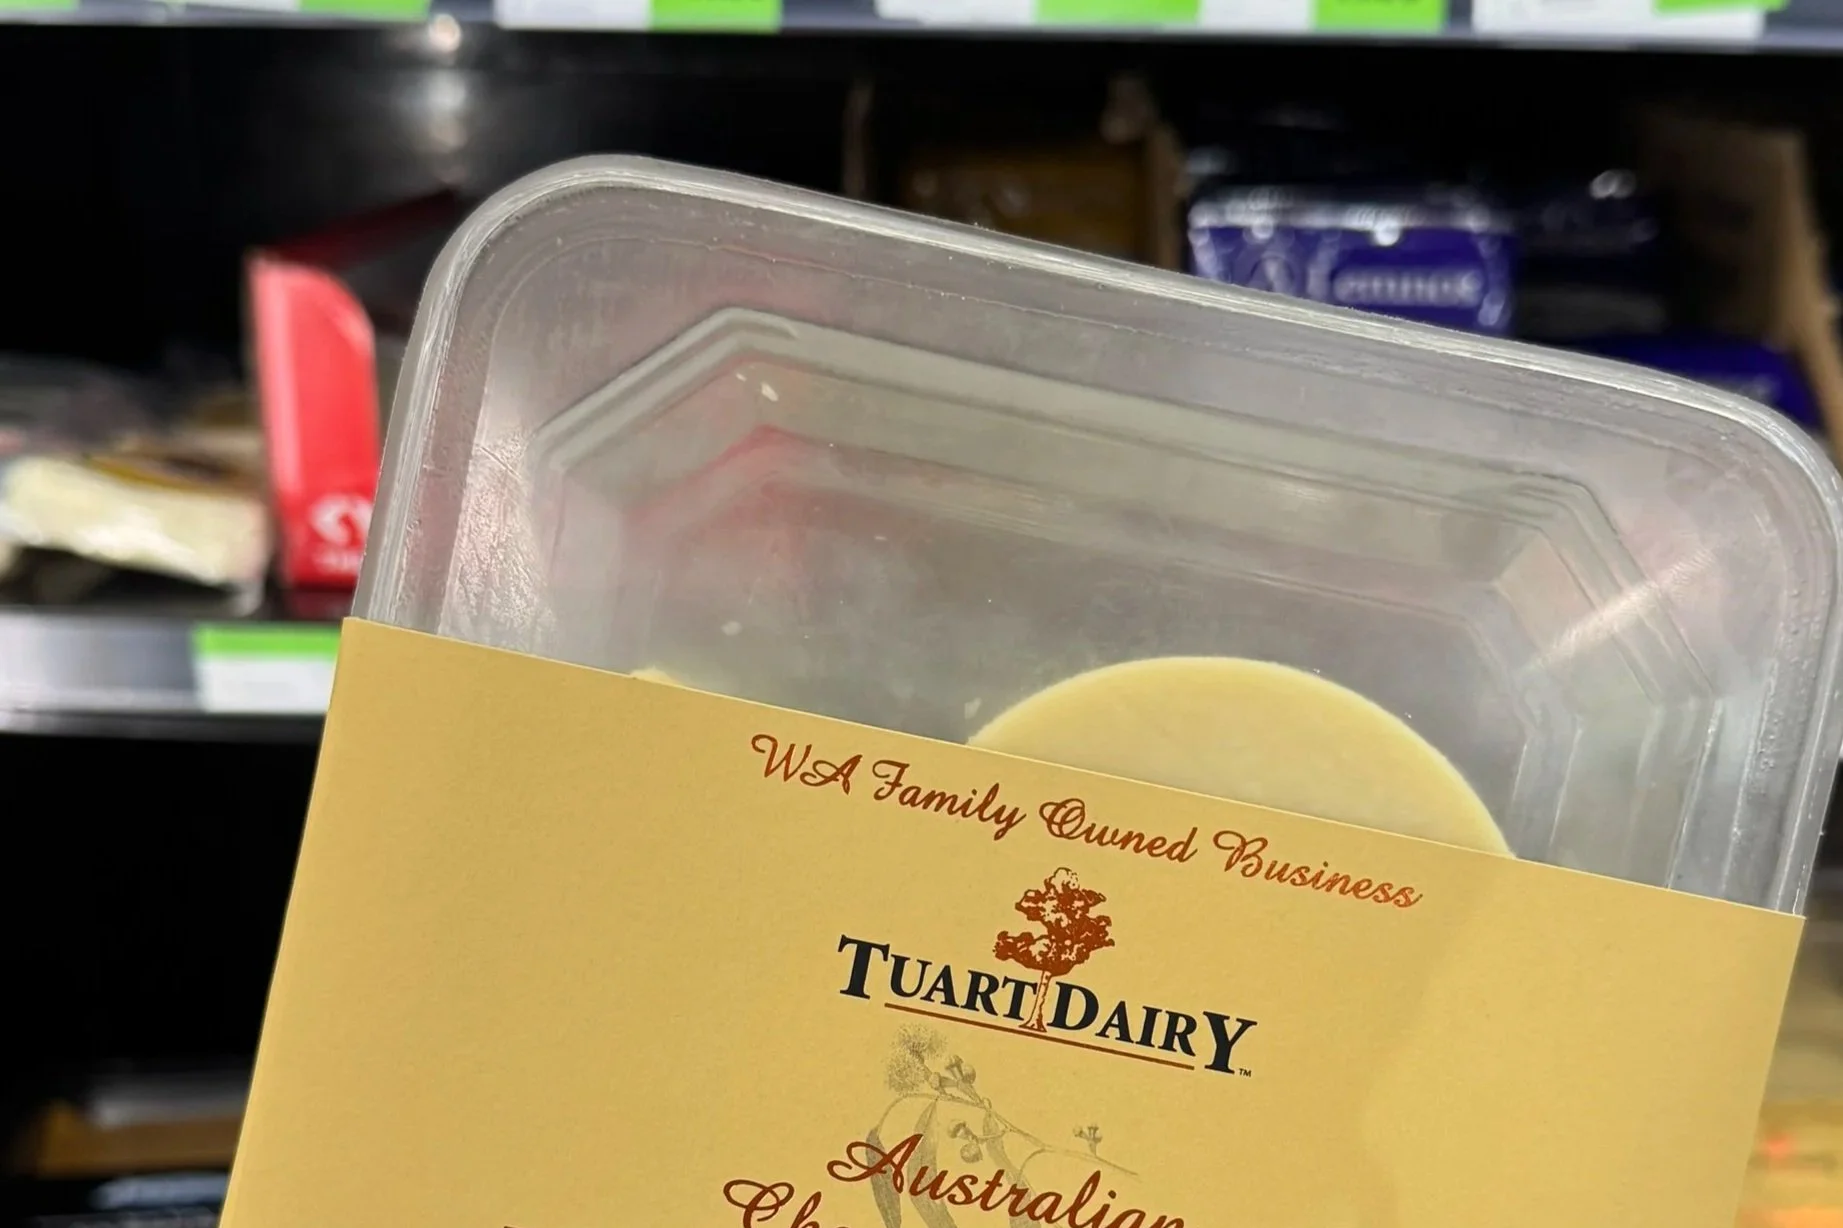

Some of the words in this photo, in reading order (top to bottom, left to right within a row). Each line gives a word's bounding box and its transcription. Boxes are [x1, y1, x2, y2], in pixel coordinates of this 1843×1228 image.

[752, 735, 863, 795] WA
[871, 759, 1027, 841] Family
[1038, 798, 1199, 864] Owned
[1212, 830, 1424, 908] Business
[837, 934, 1039, 1022] TUART
[1046, 981, 1258, 1075] DAIRY
